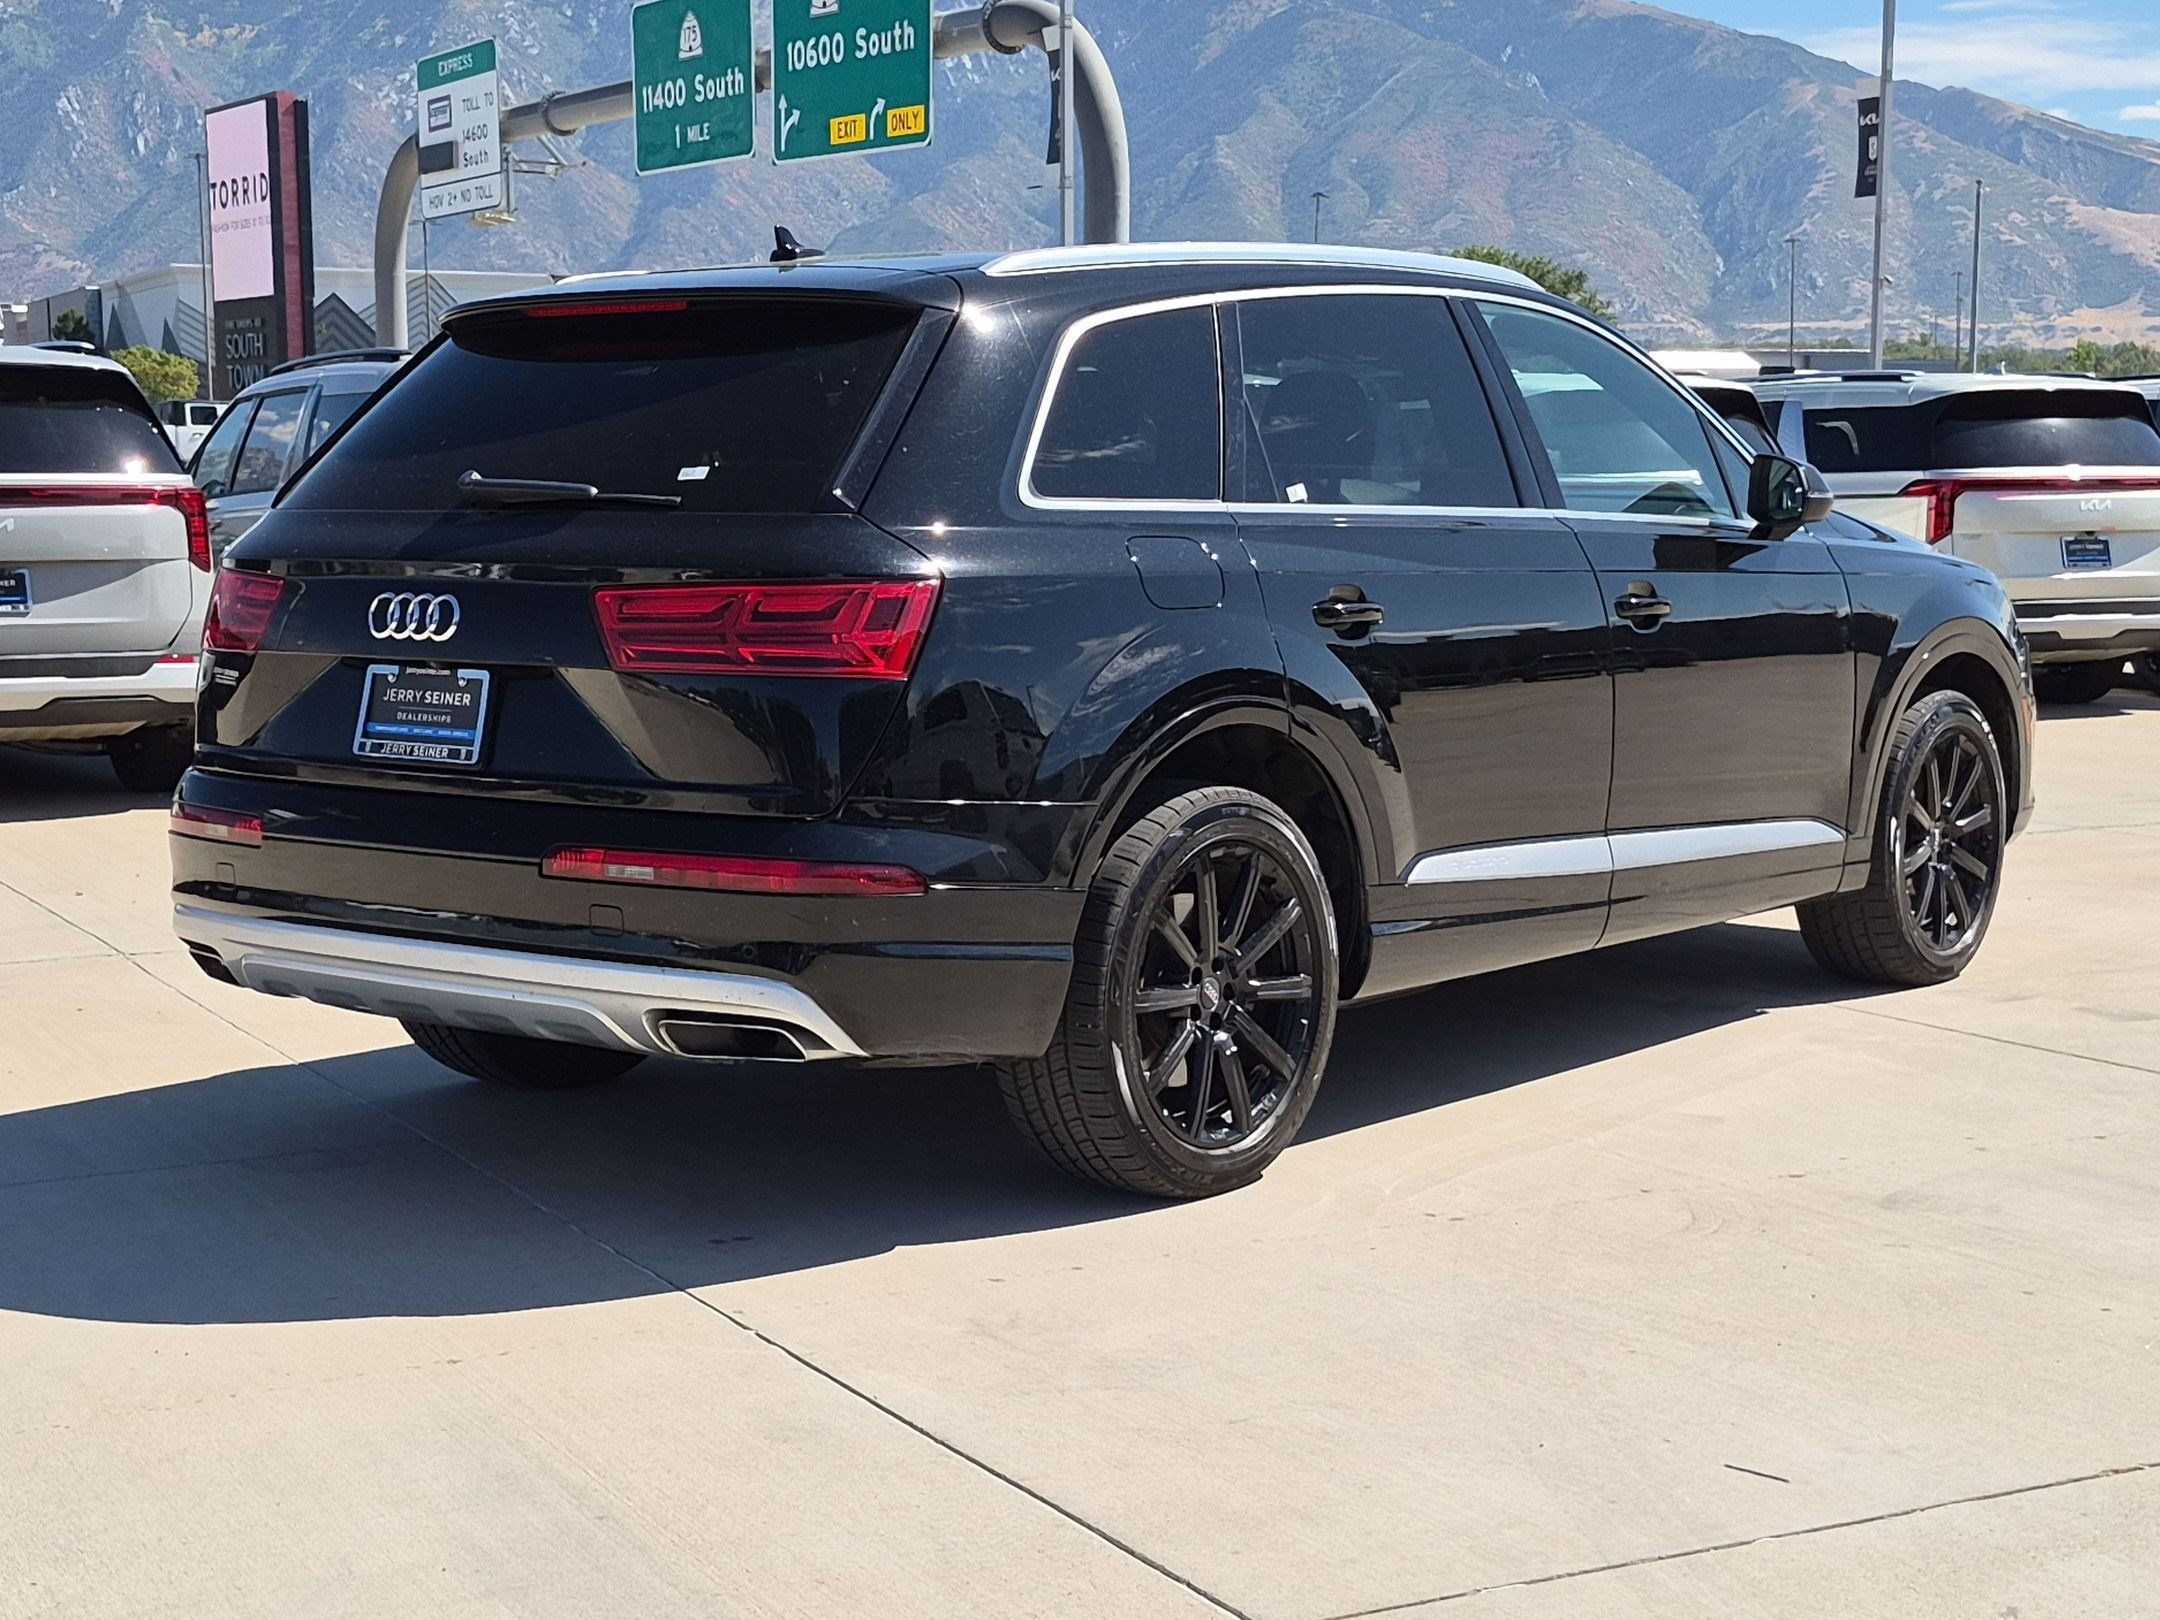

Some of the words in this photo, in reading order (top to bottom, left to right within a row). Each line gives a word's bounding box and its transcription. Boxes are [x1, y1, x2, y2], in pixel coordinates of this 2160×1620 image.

[683, 25, 697, 43] 175
[786, 32, 845, 72] 10600
[854, 19, 915, 59] South
[438, 52, 473, 77] EXPRESS
[462, 96, 481, 113] TOLL
[484, 91, 494, 107] TO
[642, 78, 686, 114] 11400
[694, 66, 744, 102] South
[463, 123, 488, 143] 14600
[675, 124, 681, 149] 1
[687, 122, 711, 143] MILE
[837, 119, 857, 140] EXIT
[890, 110, 921, 132] ONLY
[463, 147, 490, 168] South
[210, 172, 269, 211] TORRID
[429, 193, 444, 209] HOV
[461, 188, 472, 203] NO
[475, 184, 494, 201] TOLL
[226, 333, 263, 359] SOUTH
[226, 364, 264, 390] TOWN
[383, 688, 423, 703] JERRY
[424, 690, 472, 707] SEINER
[396, 711, 451, 724] DEALERSHIPS
[380, 743, 413, 755] JERRY
[413, 745, 449, 759] SEINER
